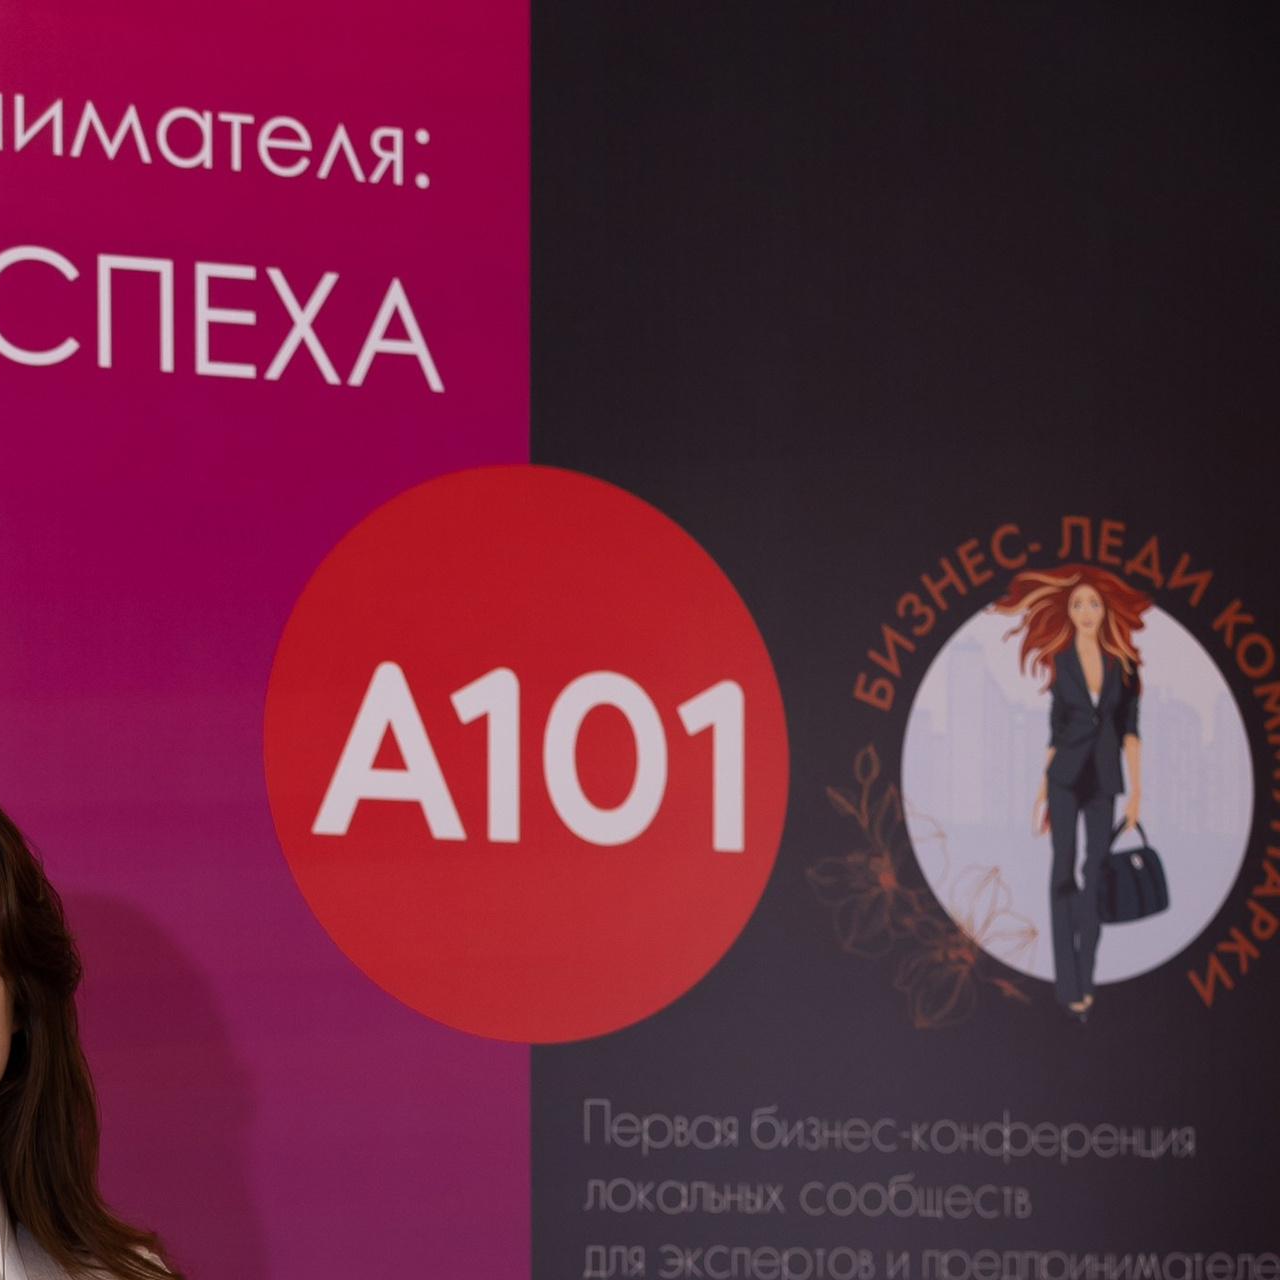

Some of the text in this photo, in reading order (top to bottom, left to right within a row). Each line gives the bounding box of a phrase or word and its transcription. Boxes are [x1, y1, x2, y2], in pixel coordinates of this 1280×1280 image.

[1057, 515, 1214, 607] ЛЕДИ
[583, 1098, 1197, 1166] Первая бизнес-конференция
[582, 1172, 1034, 1221] локальных сообществ
[582, 1244, 647, 1280] для
